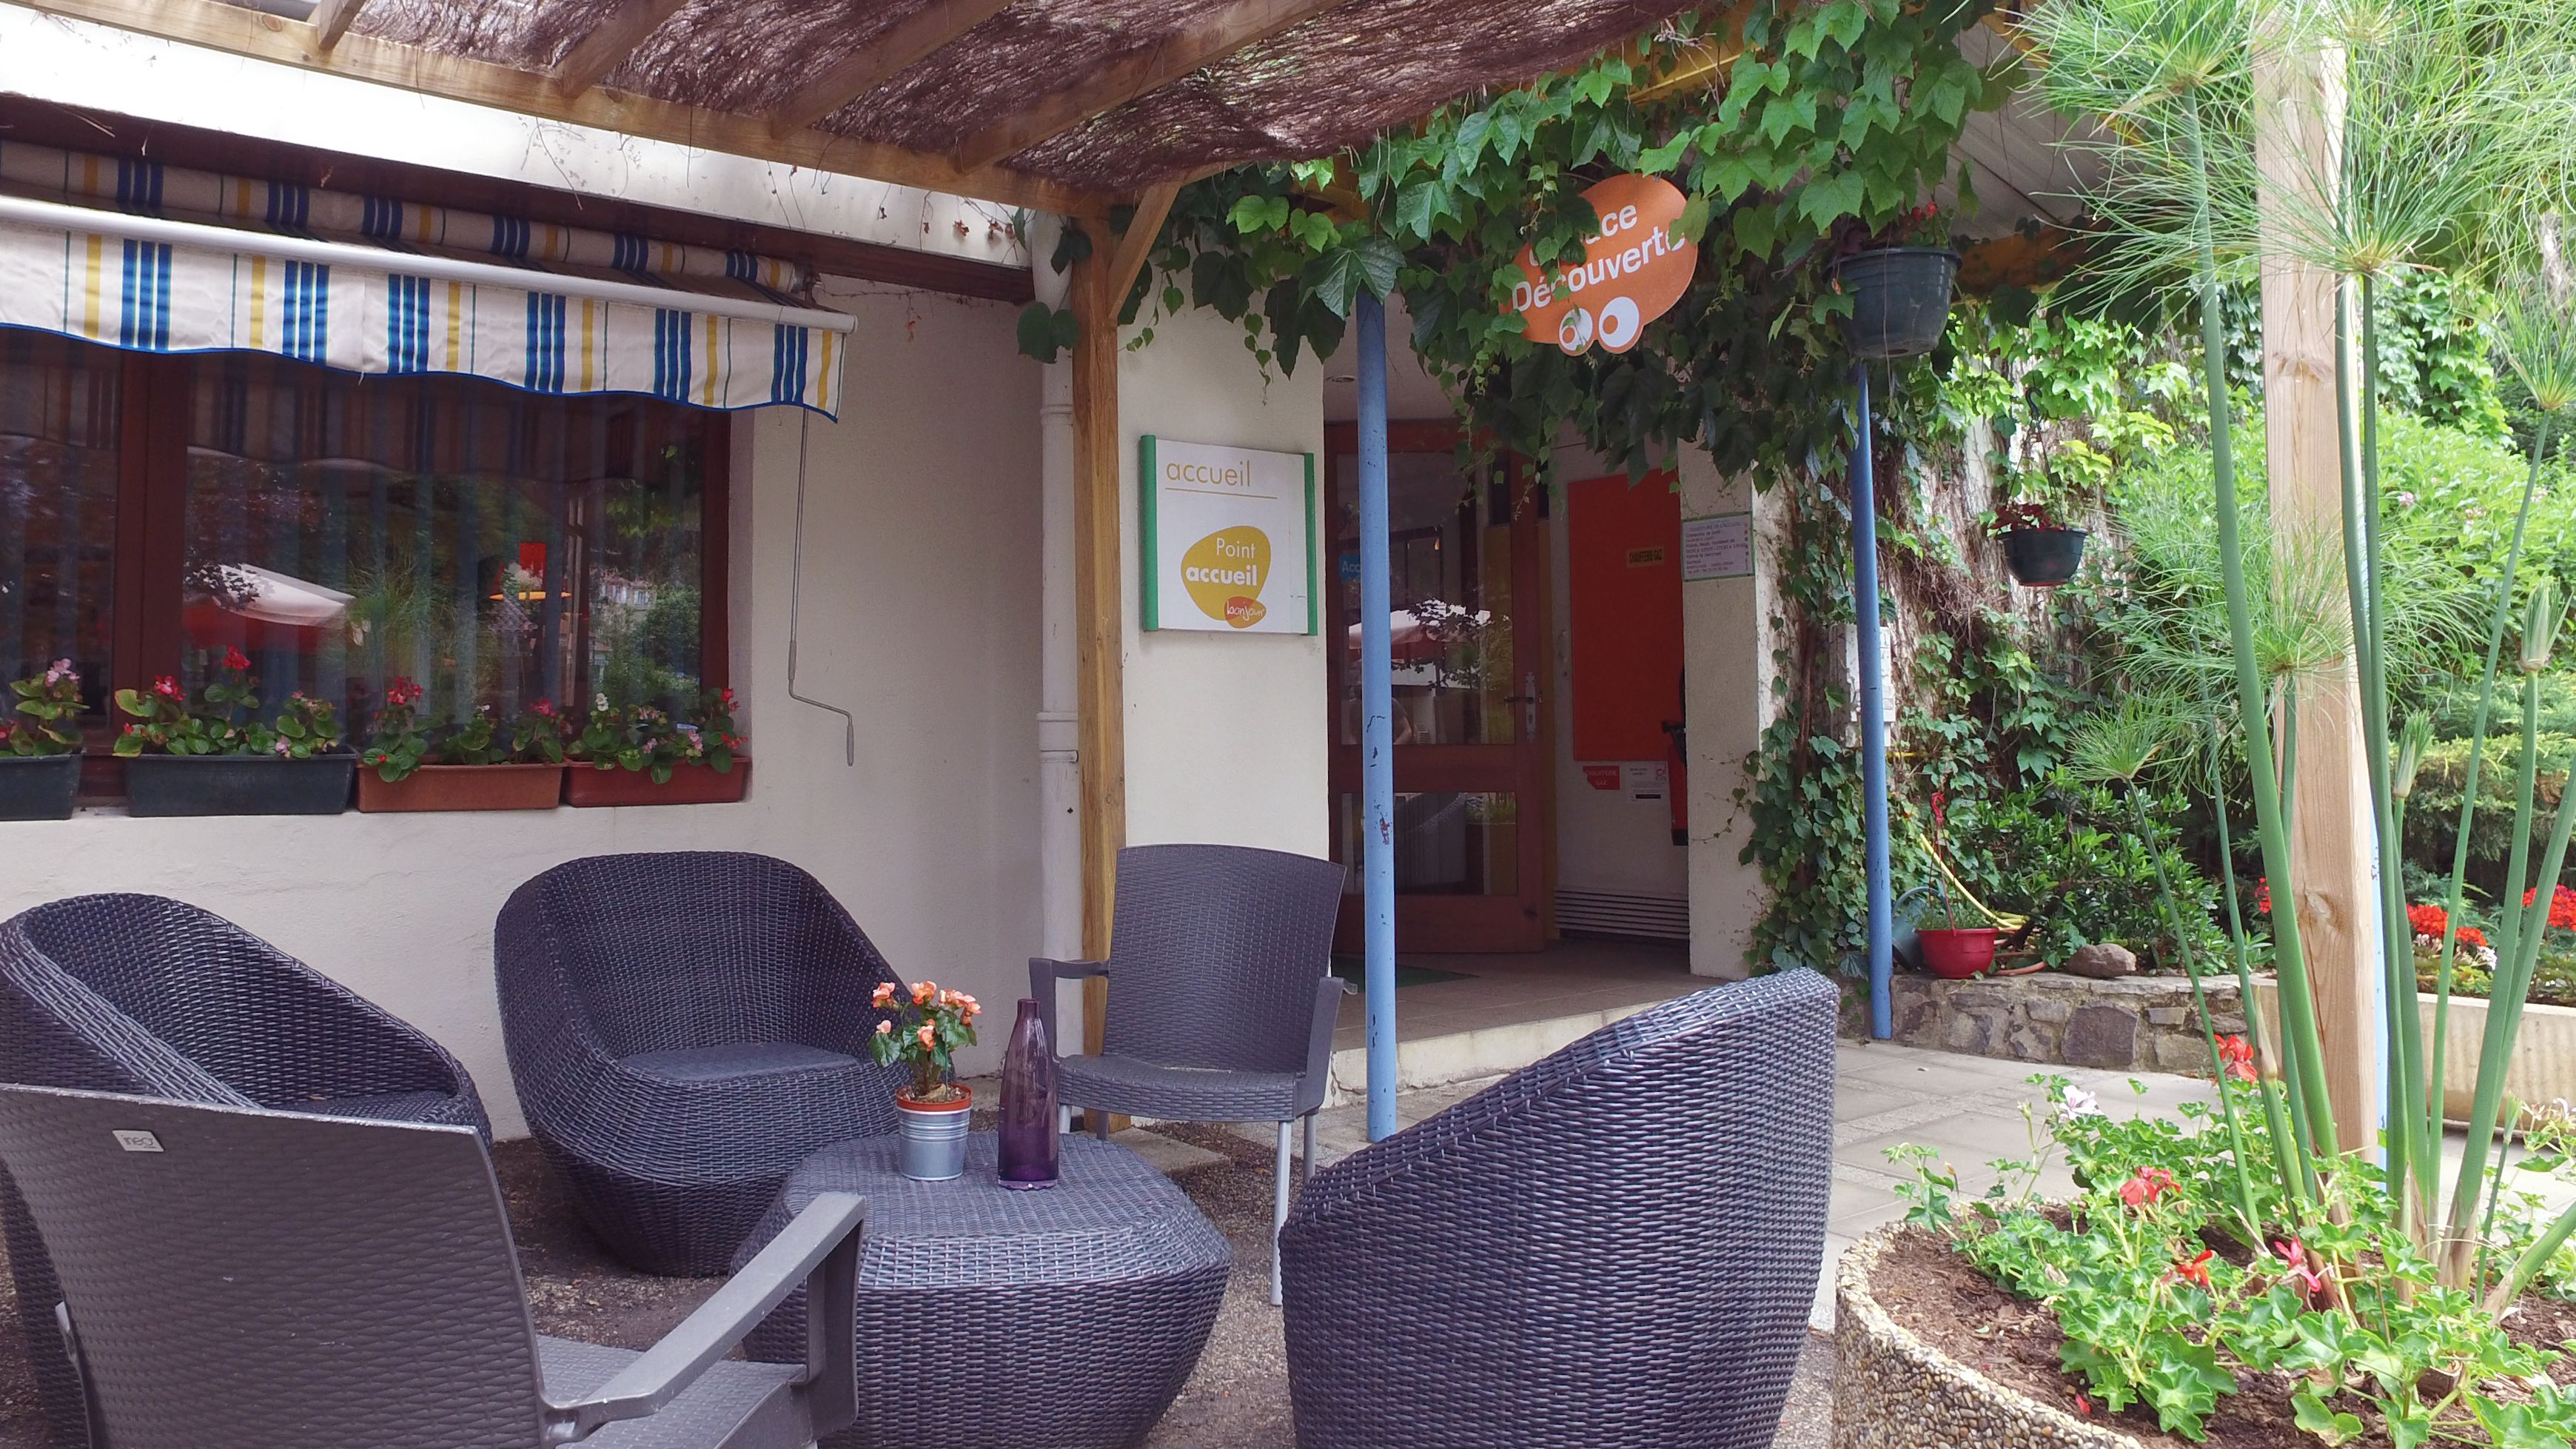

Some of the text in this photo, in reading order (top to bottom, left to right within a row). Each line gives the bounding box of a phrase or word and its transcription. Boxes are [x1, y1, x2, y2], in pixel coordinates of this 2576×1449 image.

[1166, 460, 1251, 487] accueil
[1216, 537, 1256, 559] Point
[1185, 564, 1258, 586] accueil
[1226, 600, 1265, 622] bonjour
